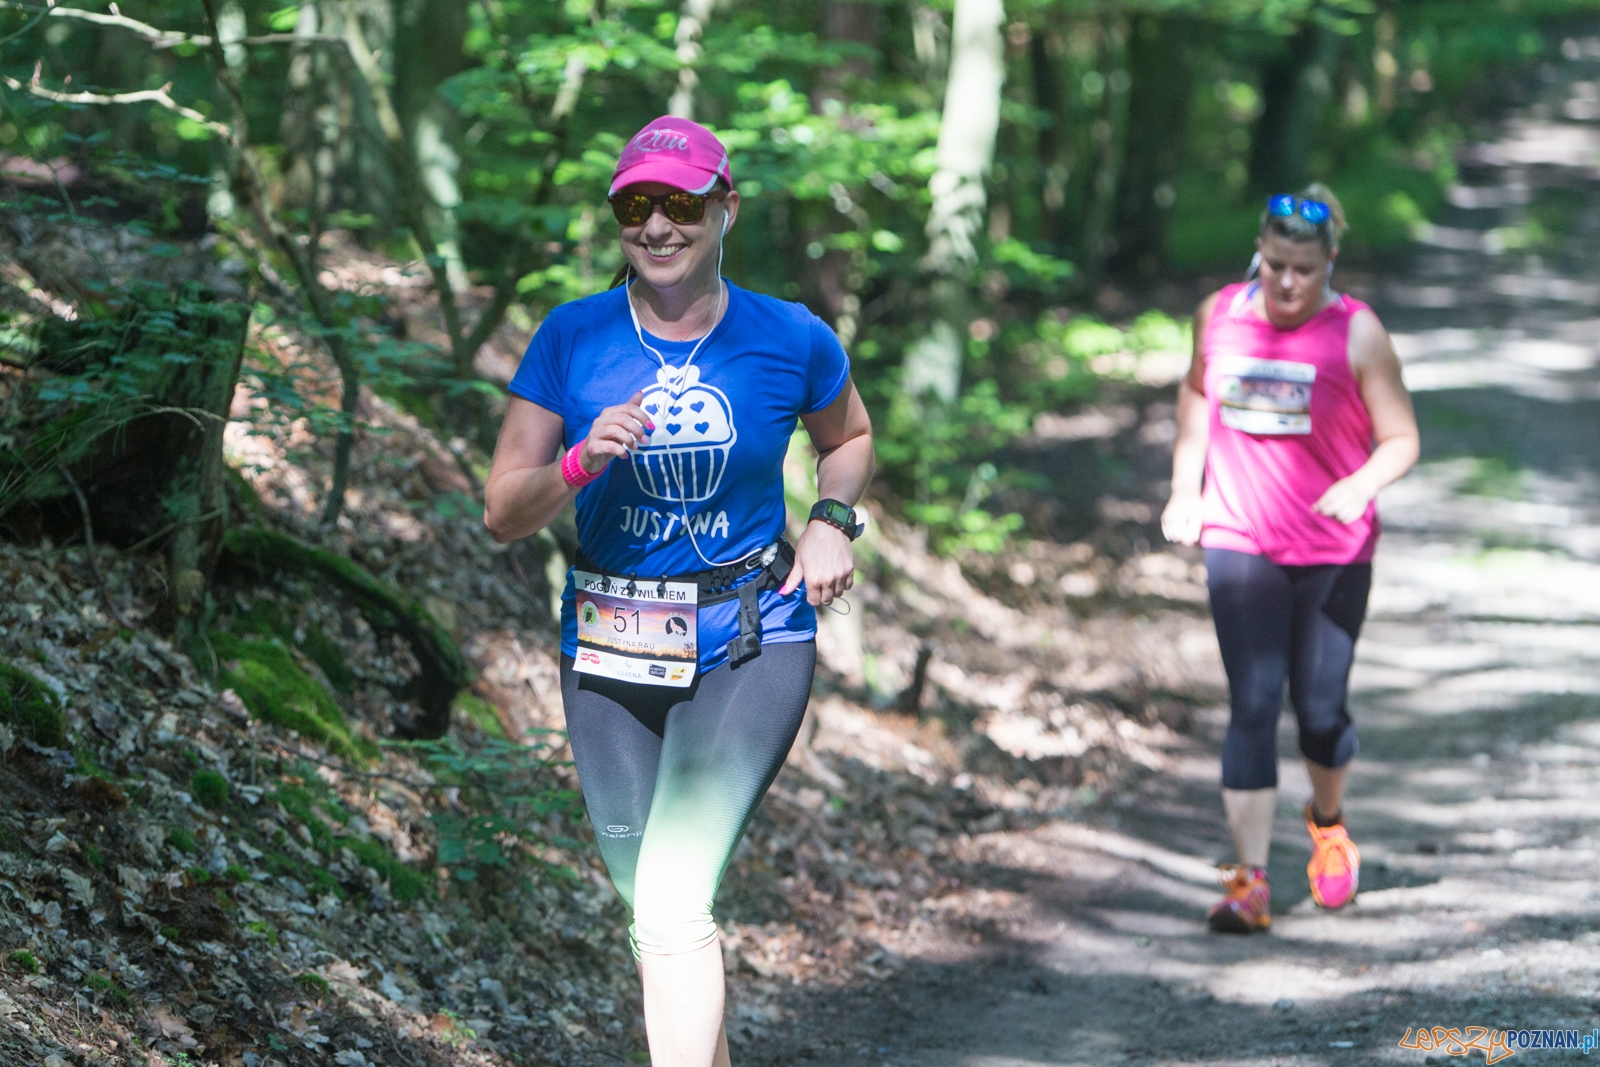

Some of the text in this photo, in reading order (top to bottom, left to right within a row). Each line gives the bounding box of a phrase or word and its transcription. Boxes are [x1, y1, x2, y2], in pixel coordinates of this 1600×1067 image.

[620, 505, 730, 541] JUSTYNA
[613, 606, 641, 635] 51
[606, 636, 655, 650] JUSTYNA RAU
[617, 669, 642, 679] LUVENA
